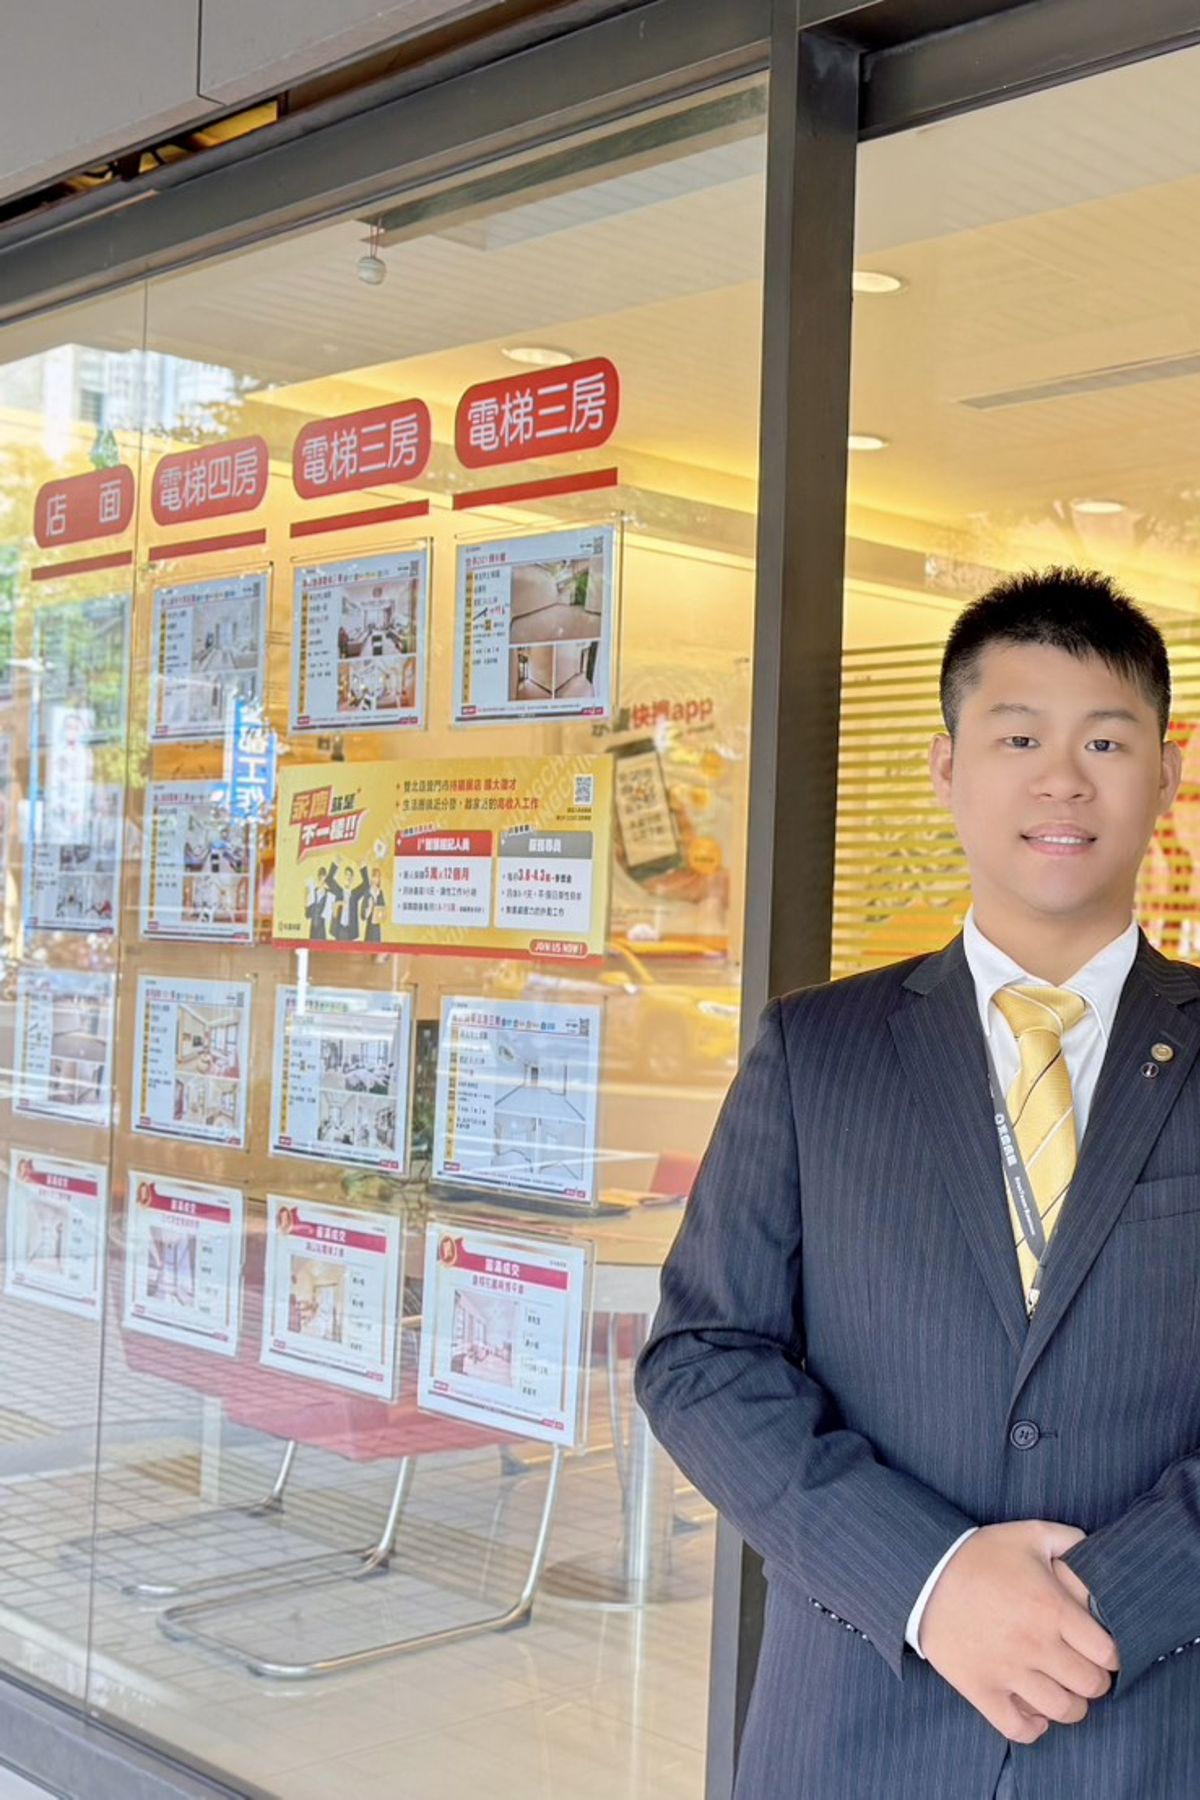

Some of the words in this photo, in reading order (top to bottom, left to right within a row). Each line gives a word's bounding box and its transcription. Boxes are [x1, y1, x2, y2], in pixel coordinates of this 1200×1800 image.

[468, 372, 606, 452] 電梯三房
[160, 447, 257, 511] 電梯四房
[302, 413, 419, 484] 電梯三房
[485, 1259, 520, 1277] 圓滿成交
